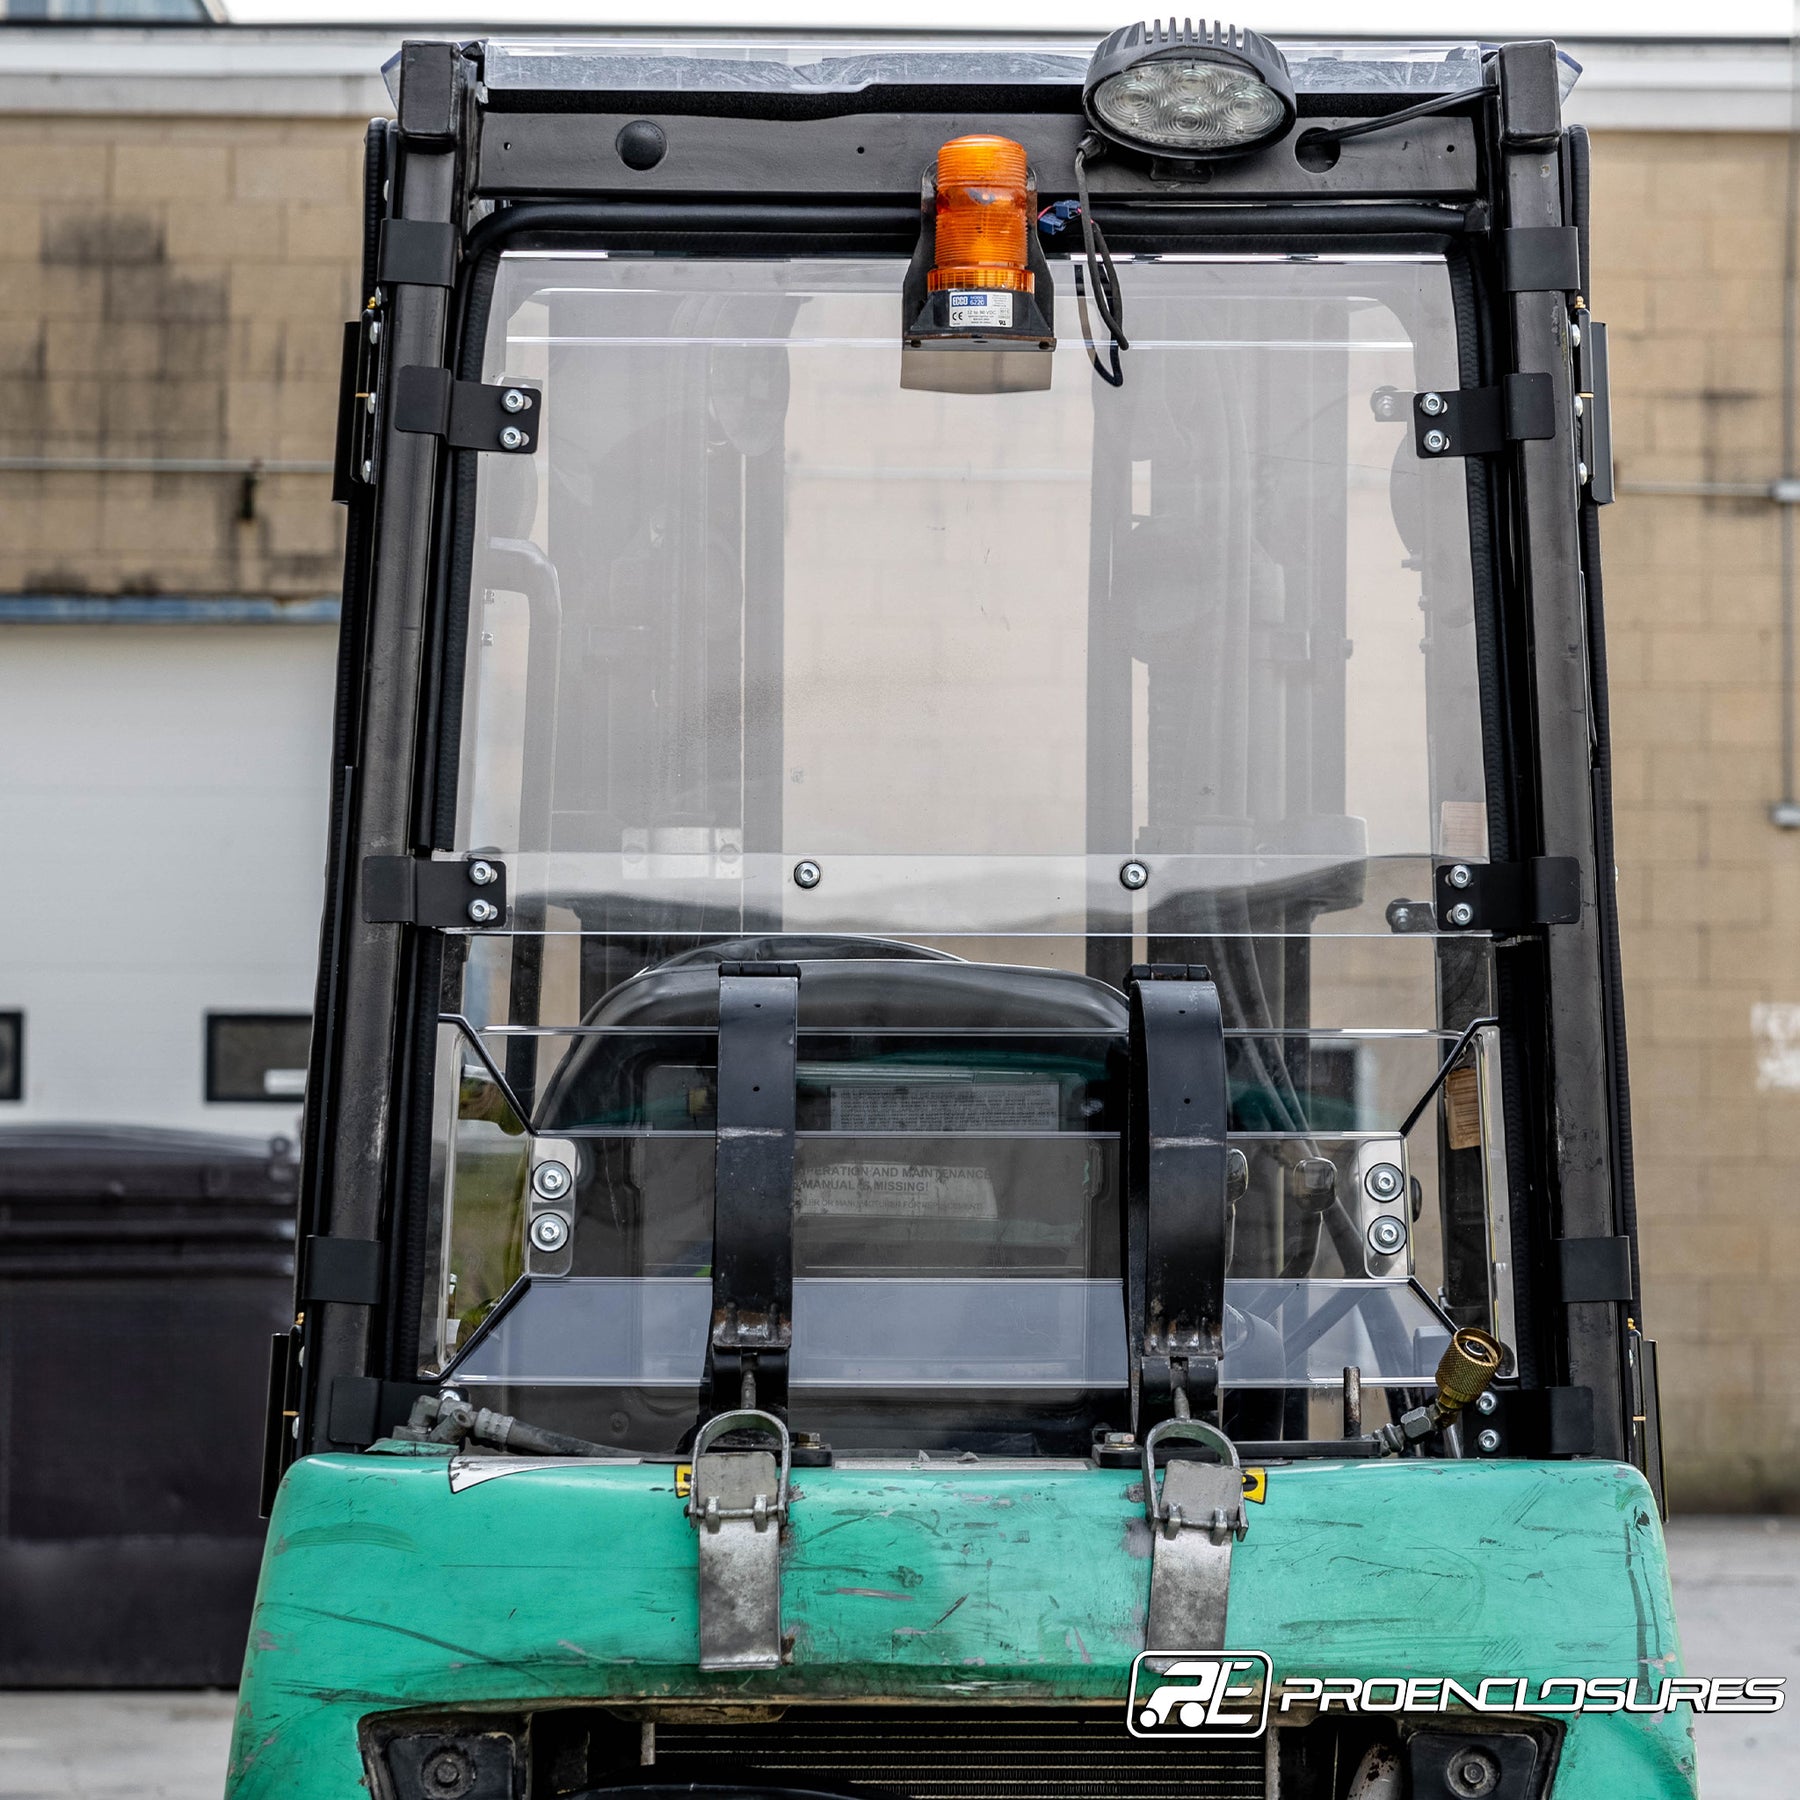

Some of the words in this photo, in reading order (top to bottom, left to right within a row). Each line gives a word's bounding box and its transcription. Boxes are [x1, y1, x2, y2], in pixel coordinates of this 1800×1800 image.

[872, 1167, 898, 1178] AND
[902, 1167, 992, 1180] MAINTENANCE
[802, 1179, 855, 1190] MANUAL
[873, 1180, 929, 1192] MISSING!
